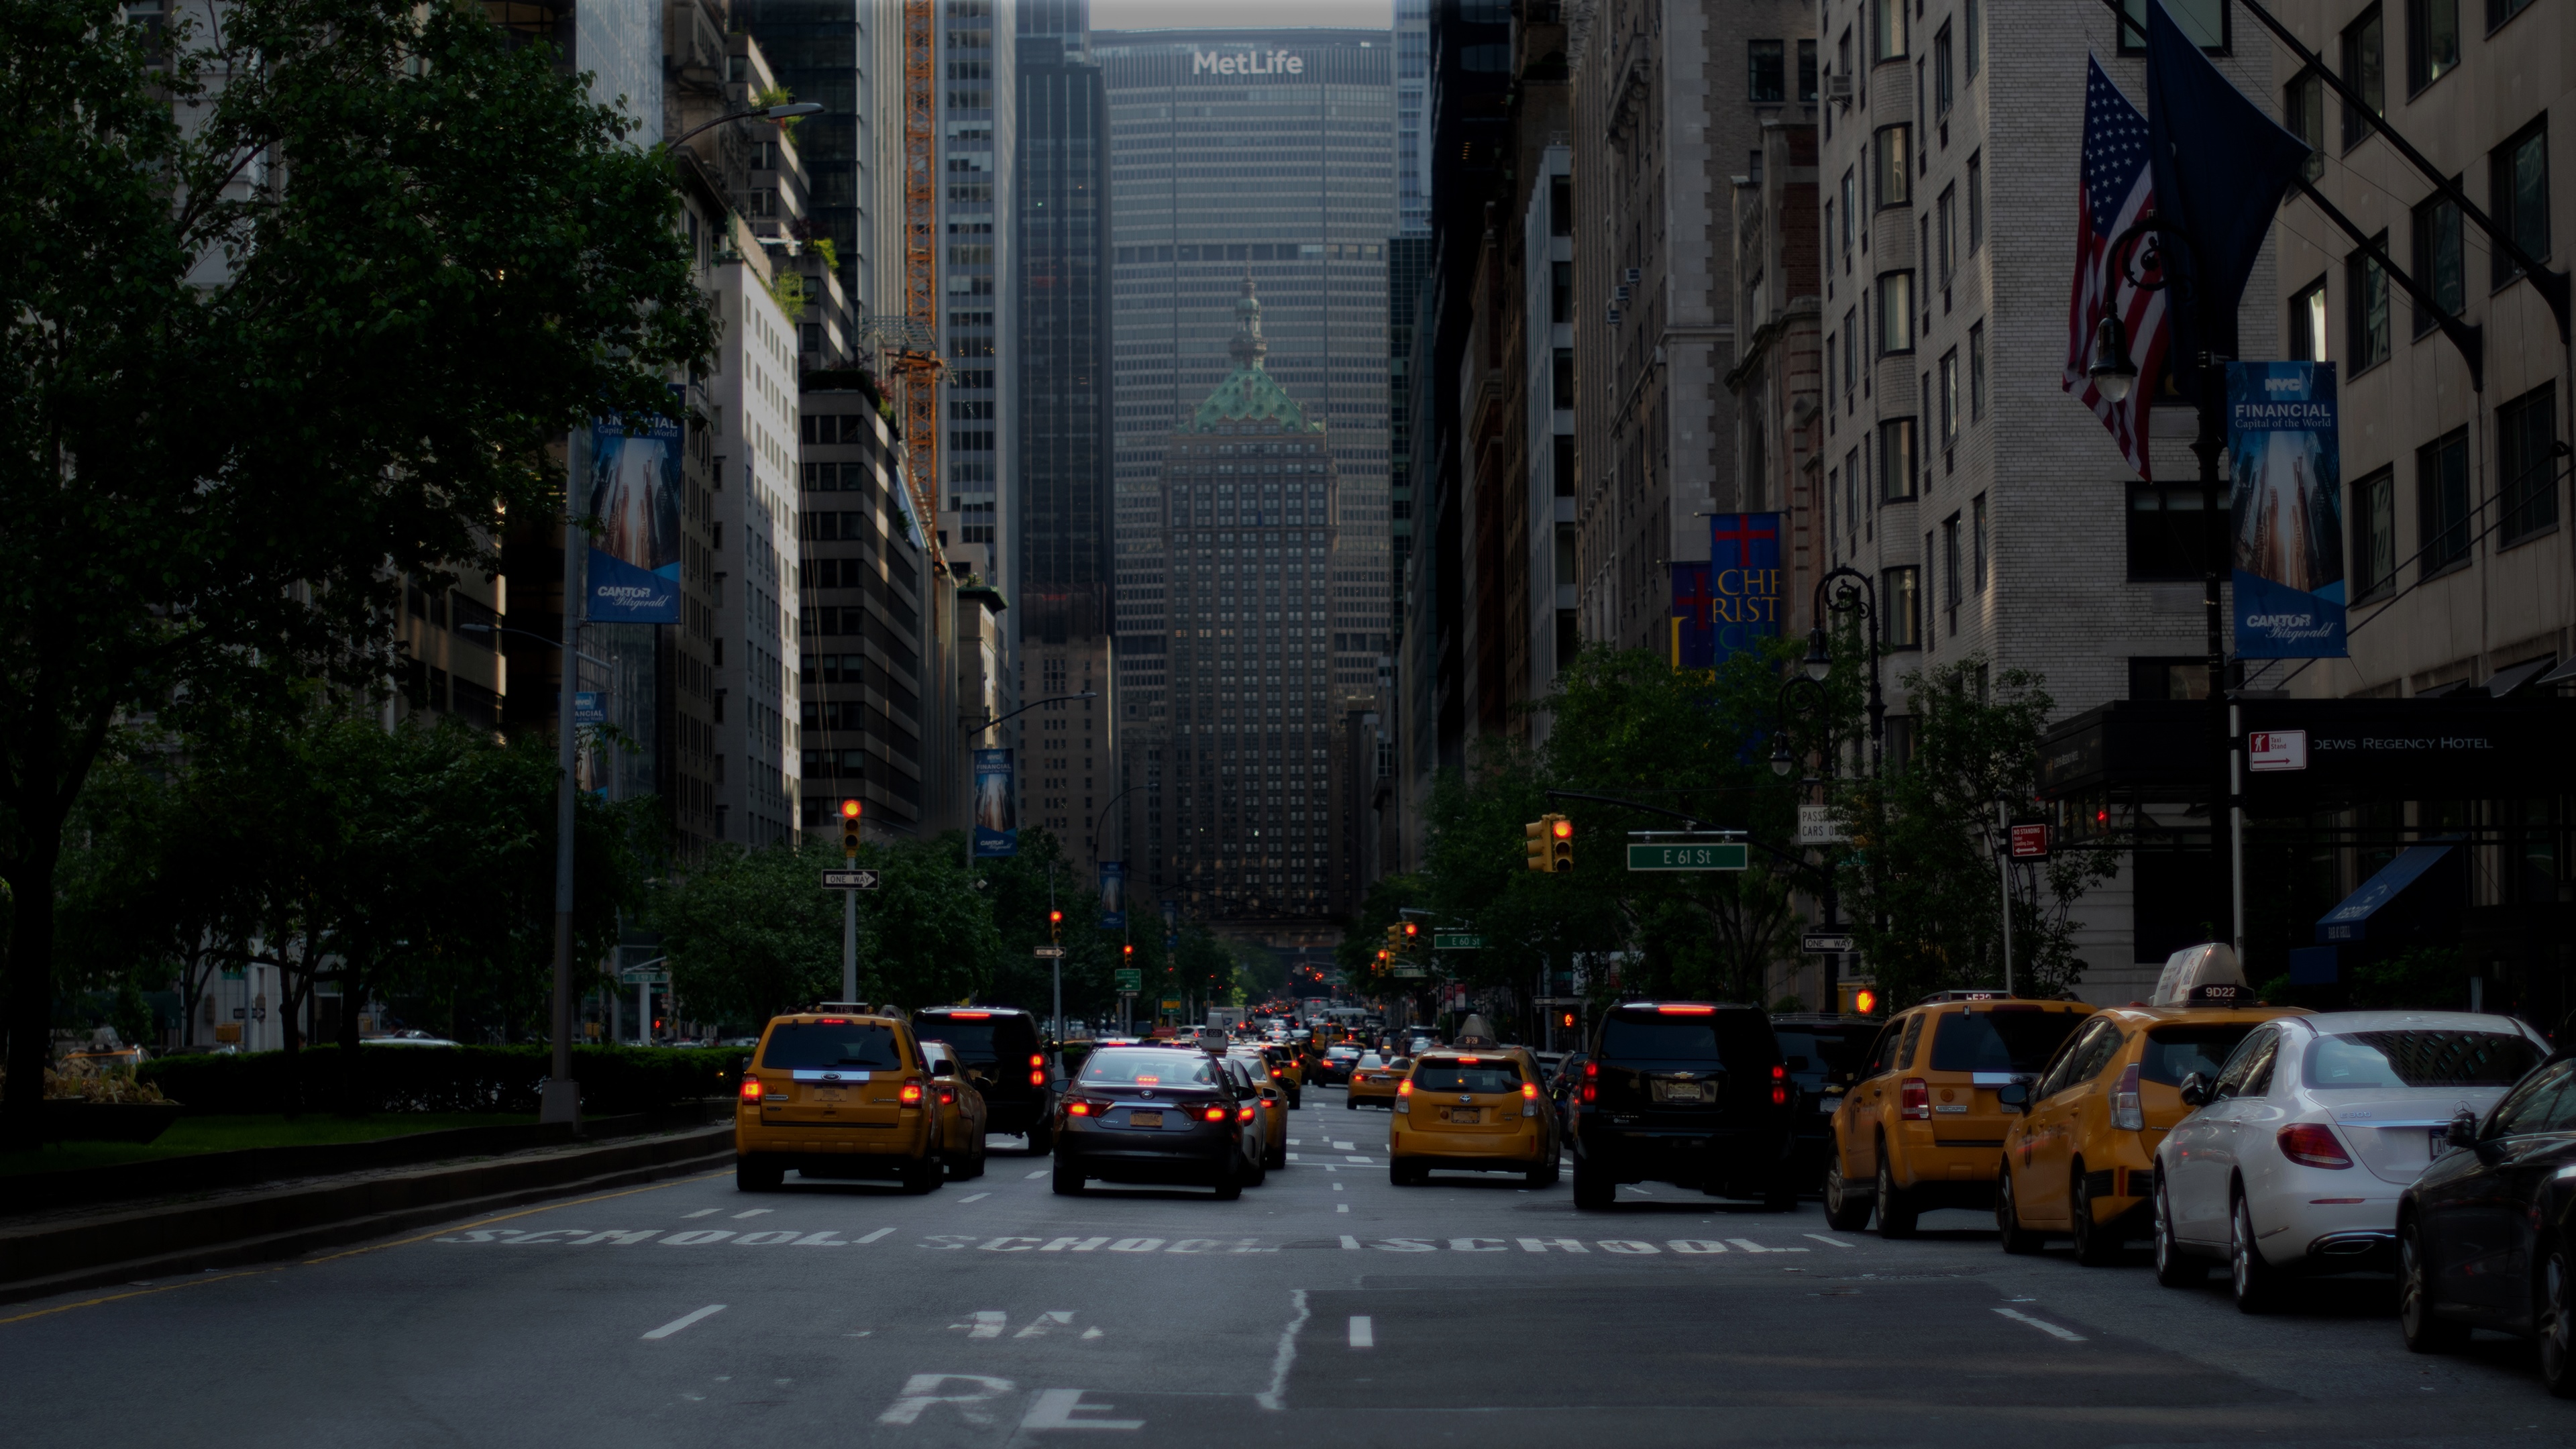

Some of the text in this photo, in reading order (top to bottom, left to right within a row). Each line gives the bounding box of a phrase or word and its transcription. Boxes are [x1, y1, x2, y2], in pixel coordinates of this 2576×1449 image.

[1193, 50, 1303, 75] MetLife
[2265, 378, 2300, 392] NYC
[2235, 404, 2331, 417] FINANCIAL
[2235, 418, 2331, 431] Capital of the World
[653, 429, 678, 437] World
[598, 586, 651, 598] CANTOR
[612, 594, 669, 611] Fitzgerald
[1713, 596, 1780, 623] RIST
[2247, 614, 2311, 628] CANTOR
[2265, 622, 2334, 644] Fitzgerald
[2314, 736, 2494, 750] OEWS REGENCY HOTEL
[1802, 826, 1823, 837] CARS
[1663, 849, 1711, 865] E 61 St
[1452, 937, 1480, 946] E 60 St
[2205, 987, 2236, 998] 9D22
[835, 1005, 853, 1013] 7Y90
[434, 1229, 851, 1246] SCHOOL
[1375, 1236, 1811, 1254] SCHOOL
